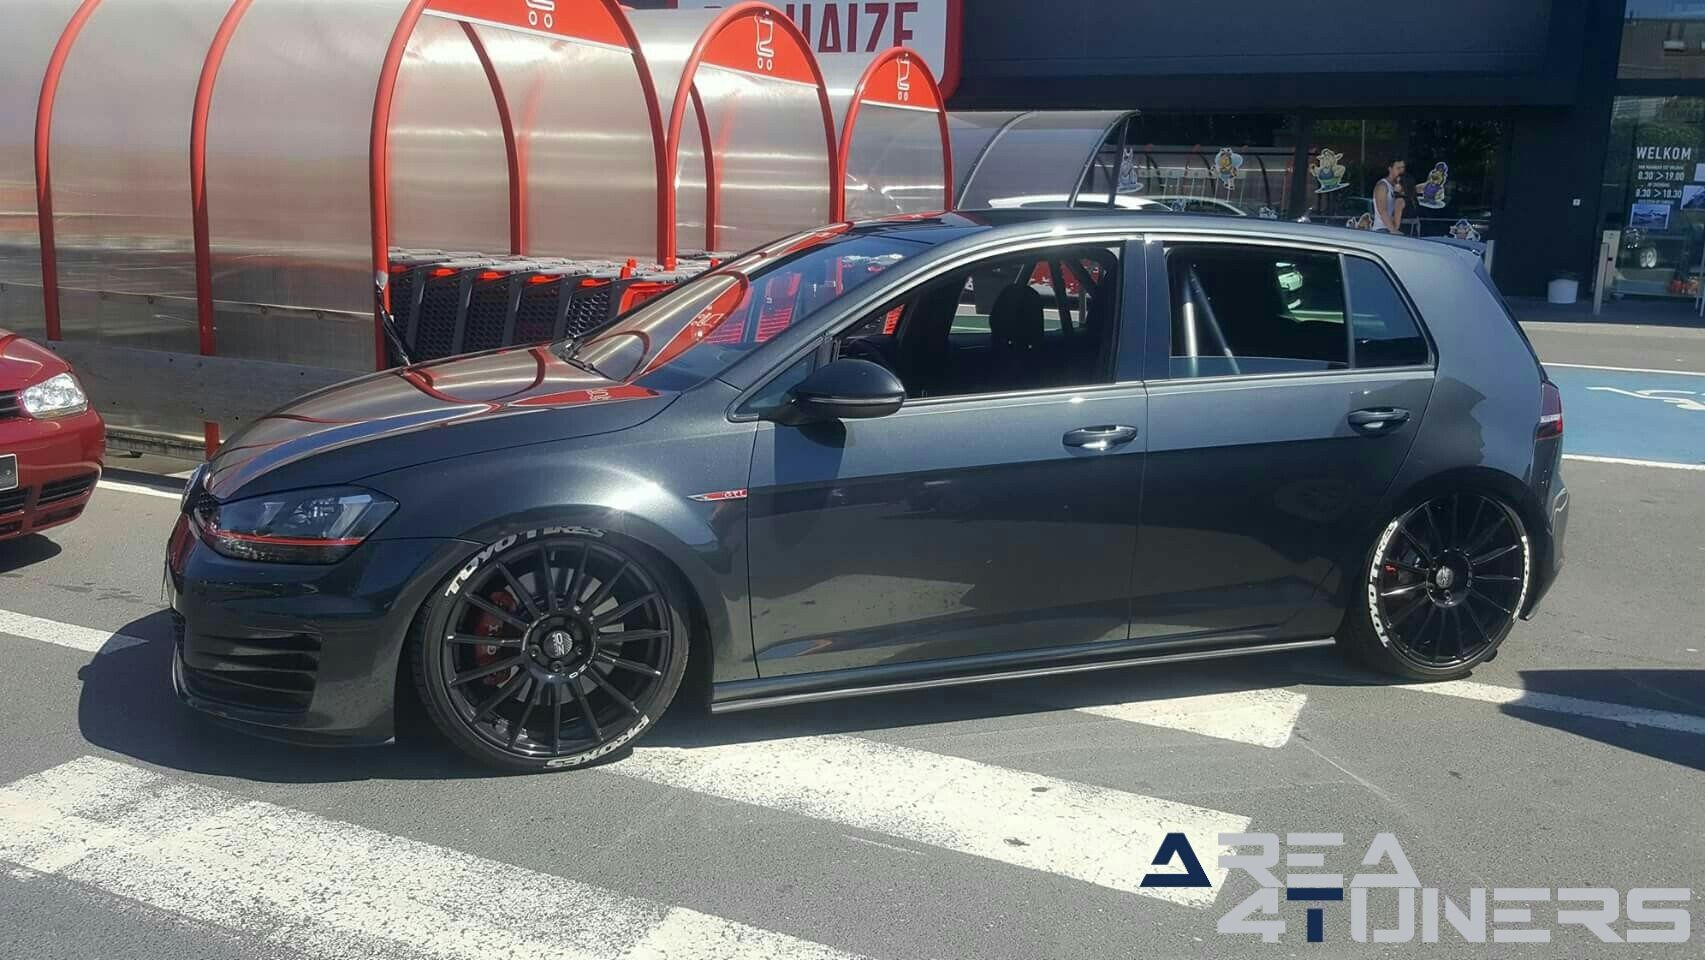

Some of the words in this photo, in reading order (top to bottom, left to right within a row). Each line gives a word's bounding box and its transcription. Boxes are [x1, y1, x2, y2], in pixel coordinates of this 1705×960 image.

[1636, 146, 1692, 160] WELKOM
[444, 534, 517, 597] TOYO
[1368, 584, 1389, 648] TOYO
